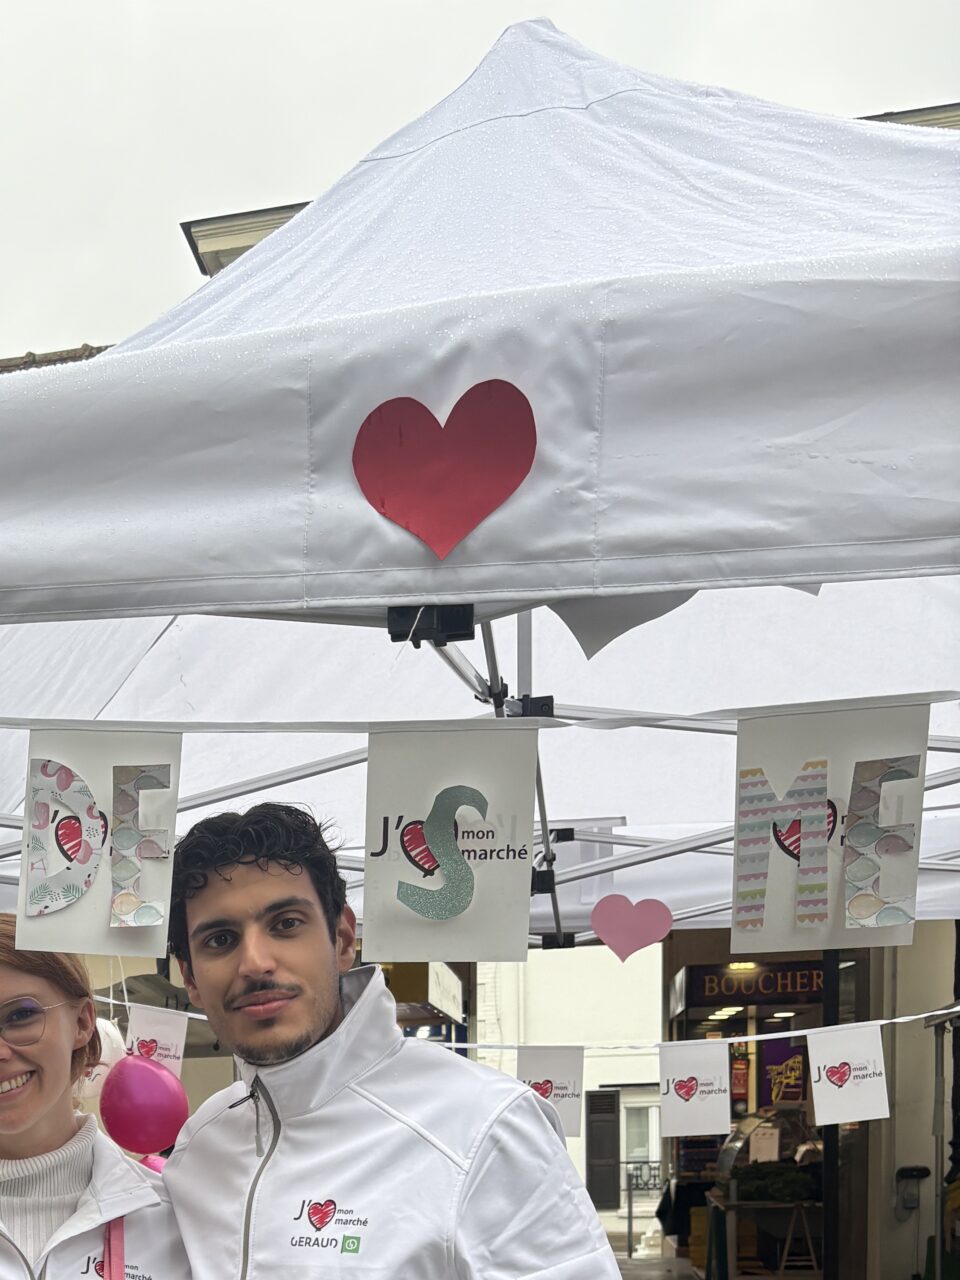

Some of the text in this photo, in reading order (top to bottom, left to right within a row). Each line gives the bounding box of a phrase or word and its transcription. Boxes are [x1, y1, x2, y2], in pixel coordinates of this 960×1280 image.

[370, 815, 494, 857] J' mon
[462, 845, 528, 860] marché
[704, 969, 823, 996] BOUCHER
[853, 1070, 883, 1080] marché
[335, 1217, 368, 1226] marché
[290, 1236, 338, 1248] GERAUD
